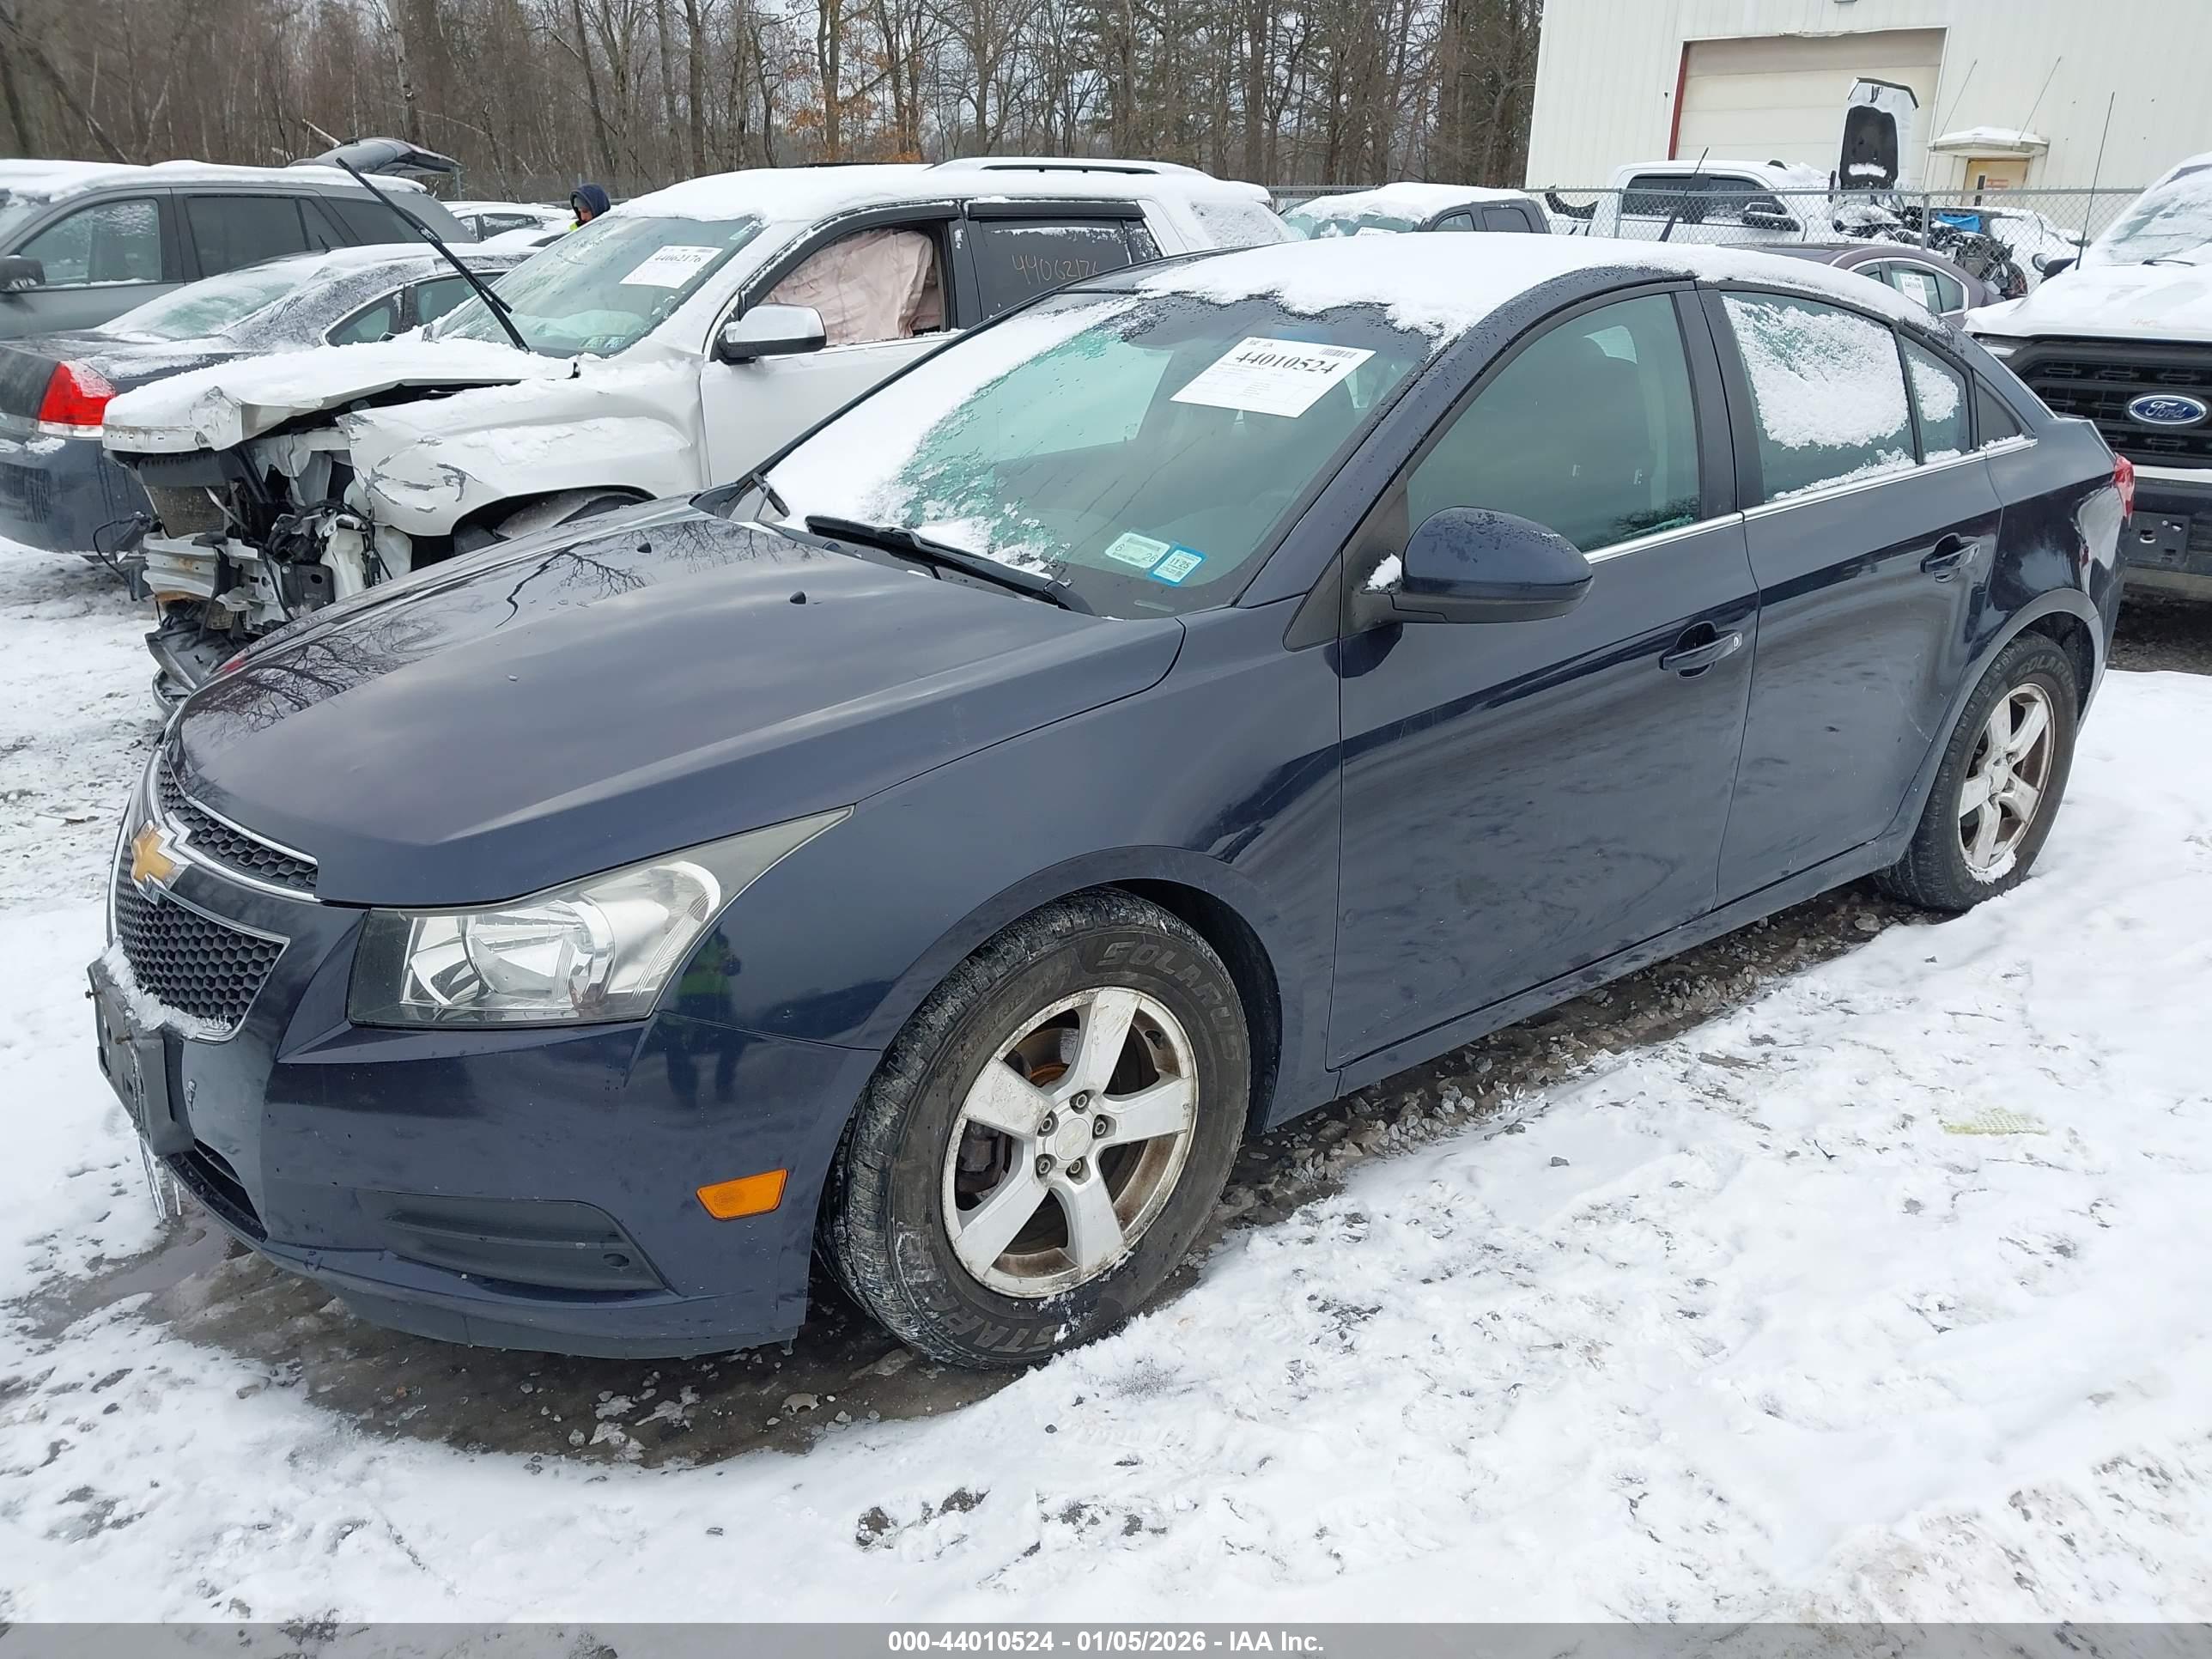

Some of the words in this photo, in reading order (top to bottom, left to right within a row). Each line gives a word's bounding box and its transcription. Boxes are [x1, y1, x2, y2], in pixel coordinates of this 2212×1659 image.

[1236, 351, 1340, 374] 44010524
[2145, 400, 2189, 418] Ford
[1097, 939, 1243, 1062] SOLARUS
